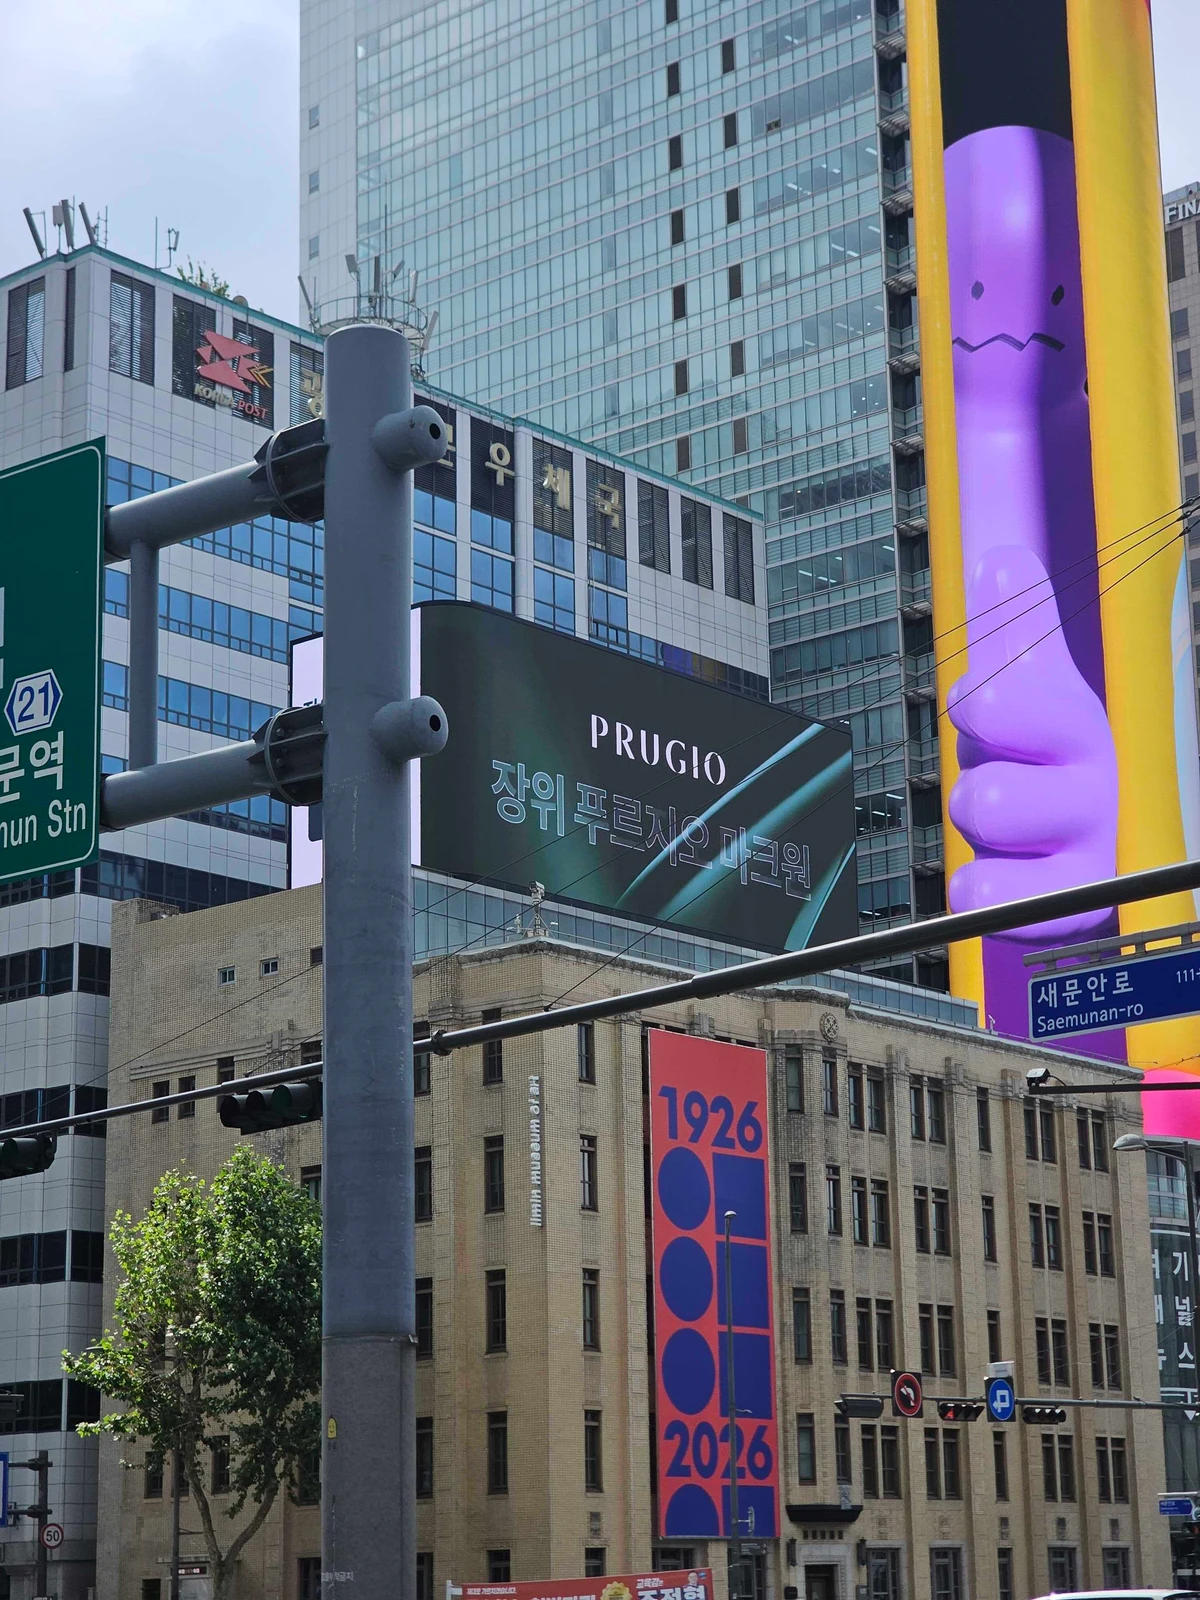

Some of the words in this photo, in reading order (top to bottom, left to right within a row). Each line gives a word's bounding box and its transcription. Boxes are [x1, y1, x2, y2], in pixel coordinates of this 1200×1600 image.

[1165, 198, 1200, 225] FIN
[194, 383, 235, 408] KOREA
[238, 400, 268, 419] POST
[18, 681, 51, 724] 21
[591, 714, 726, 786] PRUGIO
[47, 799, 86, 838] Stn
[491, 759, 565, 837] 장위
[574, 782, 713, 870] 푸르지오
[719, 825, 812, 901] 마크원
[1037, 971, 1134, 1008] 새문안로
[1037, 1003, 1144, 1033] Saemunan-ro
[528, 1075, 540, 1096] art
[528, 1098, 540, 1115] of
[658, 1085, 763, 1153] 1926
[530, 1119, 541, 1185] museum
[664, 1420, 773, 1480] 2026
[46, 1530, 60, 1542] 50
